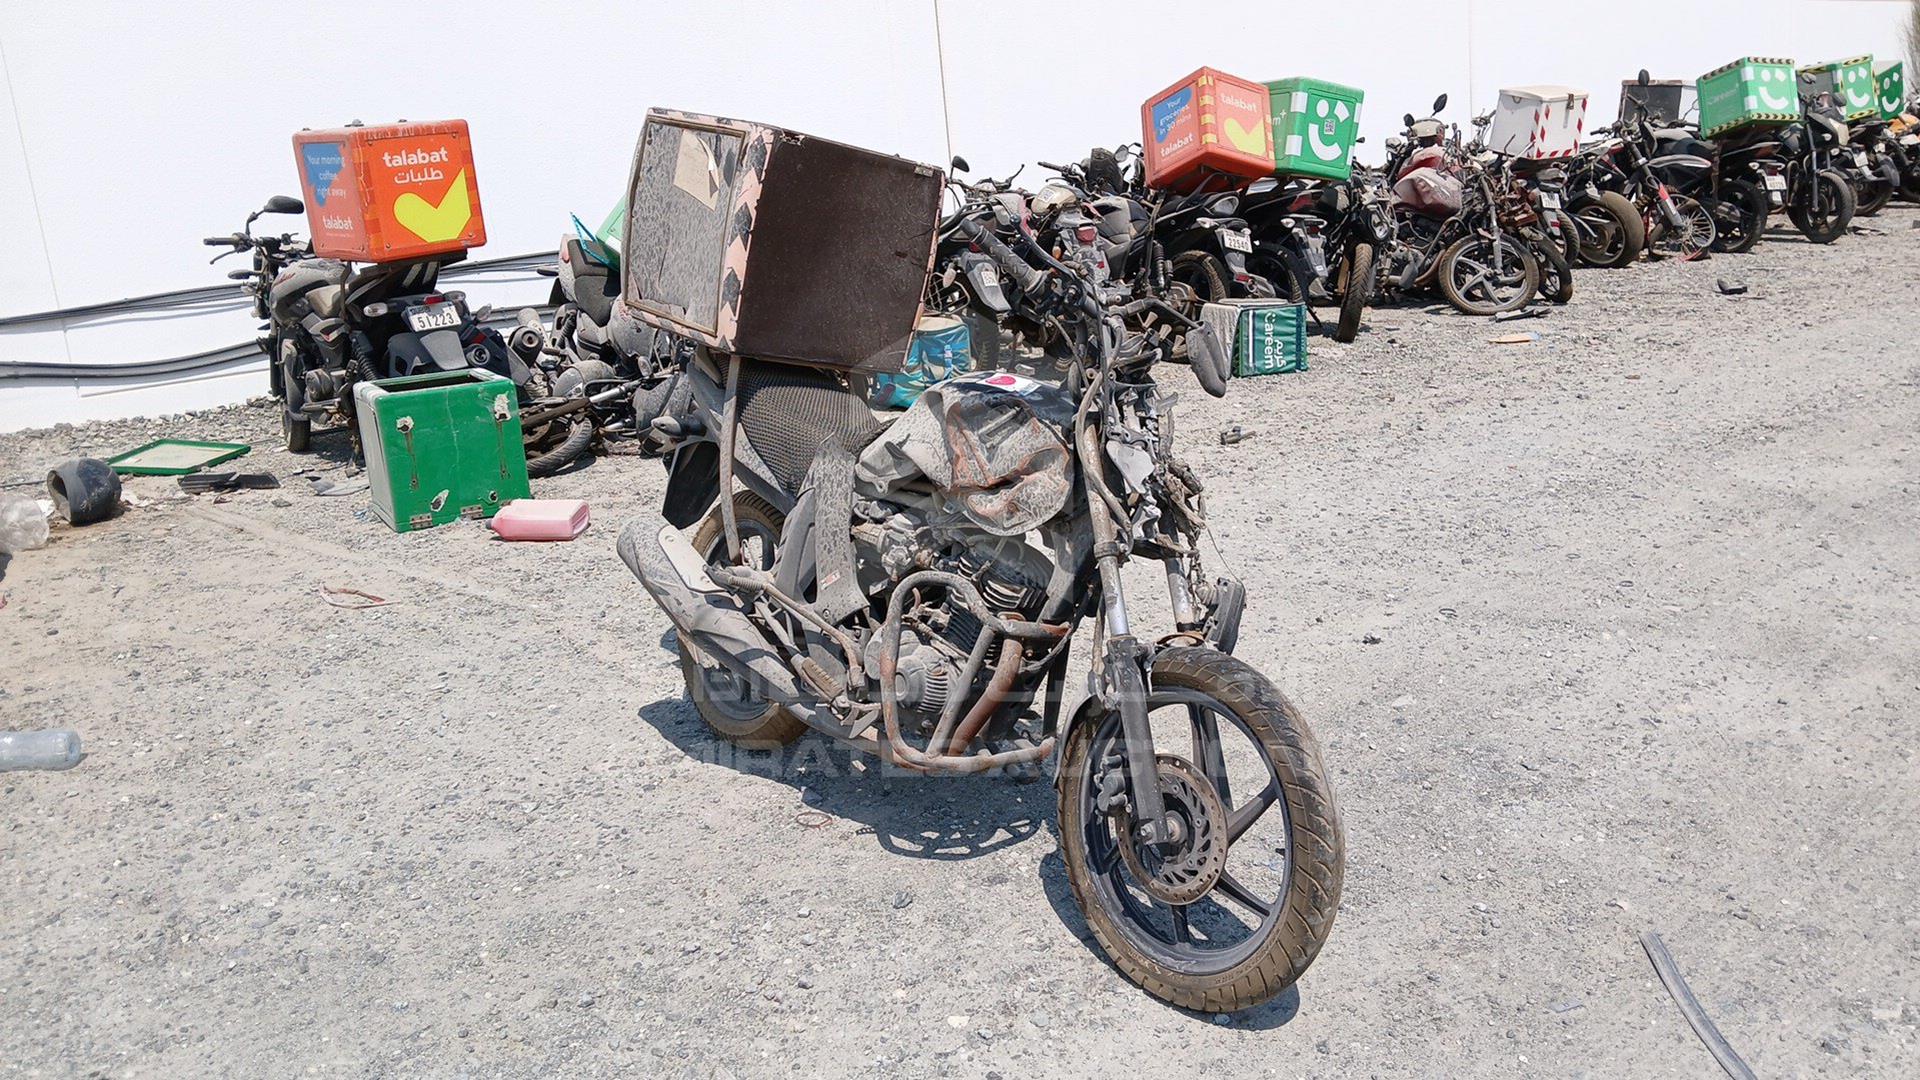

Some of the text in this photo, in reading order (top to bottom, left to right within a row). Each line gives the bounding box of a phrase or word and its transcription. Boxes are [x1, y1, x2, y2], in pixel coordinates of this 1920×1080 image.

[1221, 93, 1257, 113] talabat
[1160, 132, 1194, 157] talabat
[382, 146, 449, 168] talabat
[394, 168, 444, 185] طلبات
[322, 214, 353, 231] talabat
[417, 312, 455, 329] 51223
[1274, 339, 1287, 368] كريم
